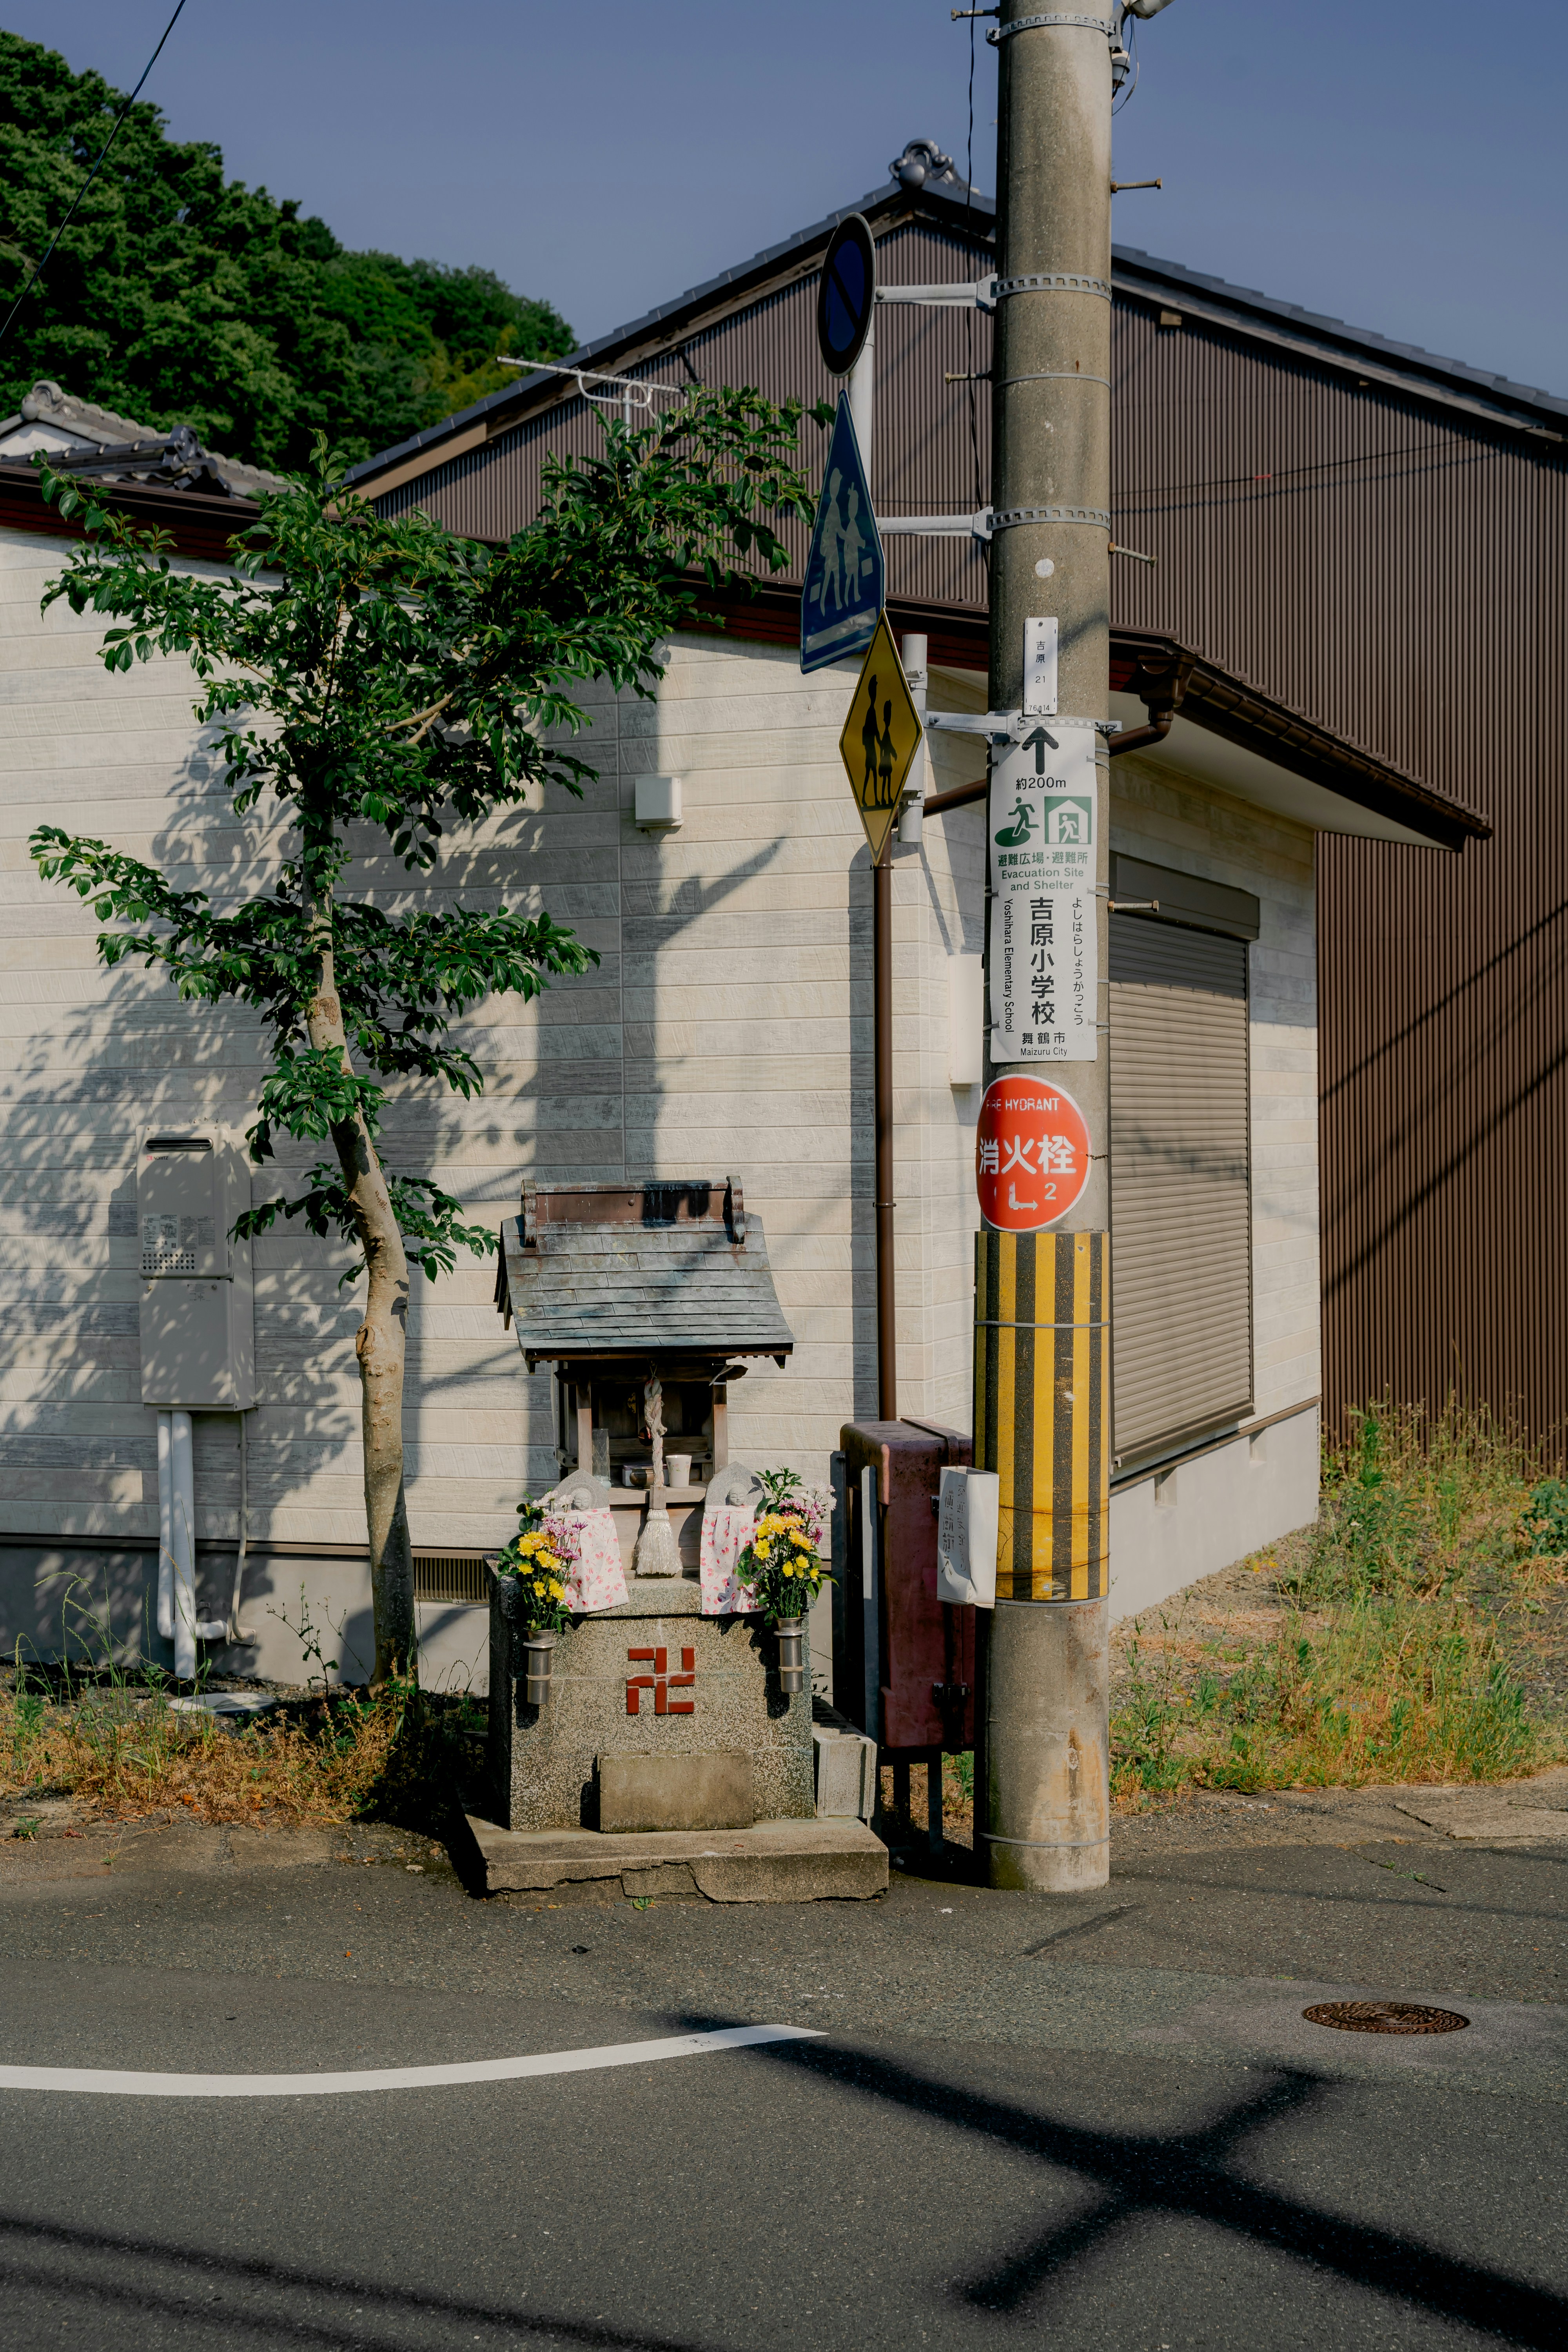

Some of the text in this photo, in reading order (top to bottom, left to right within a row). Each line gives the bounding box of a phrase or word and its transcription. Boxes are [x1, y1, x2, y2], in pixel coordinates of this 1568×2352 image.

[1036, 640, 1046, 664] 吉原
[1016, 777, 1066, 790] 約200m
[998, 851, 1088, 867] 避難広場・避難所
[1002, 867, 1084, 879] Evacuation Site
[1011, 880, 1074, 891] and Shelter
[1003, 898, 1014, 1033] Yoshihara Elementary School
[1030, 897, 1055, 1025] 吉原小学校
[1072, 898, 1084, 1025] よしはらしょうがっこう
[1022, 1032, 1065, 1045] 舞鶴市
[1053, 1047, 1067, 1056] City
[1005, 1098, 1060, 1111] HYDRANT
[980, 1134, 1077, 1174] 消火栓
[1045, 1182, 1056, 1200] 2
